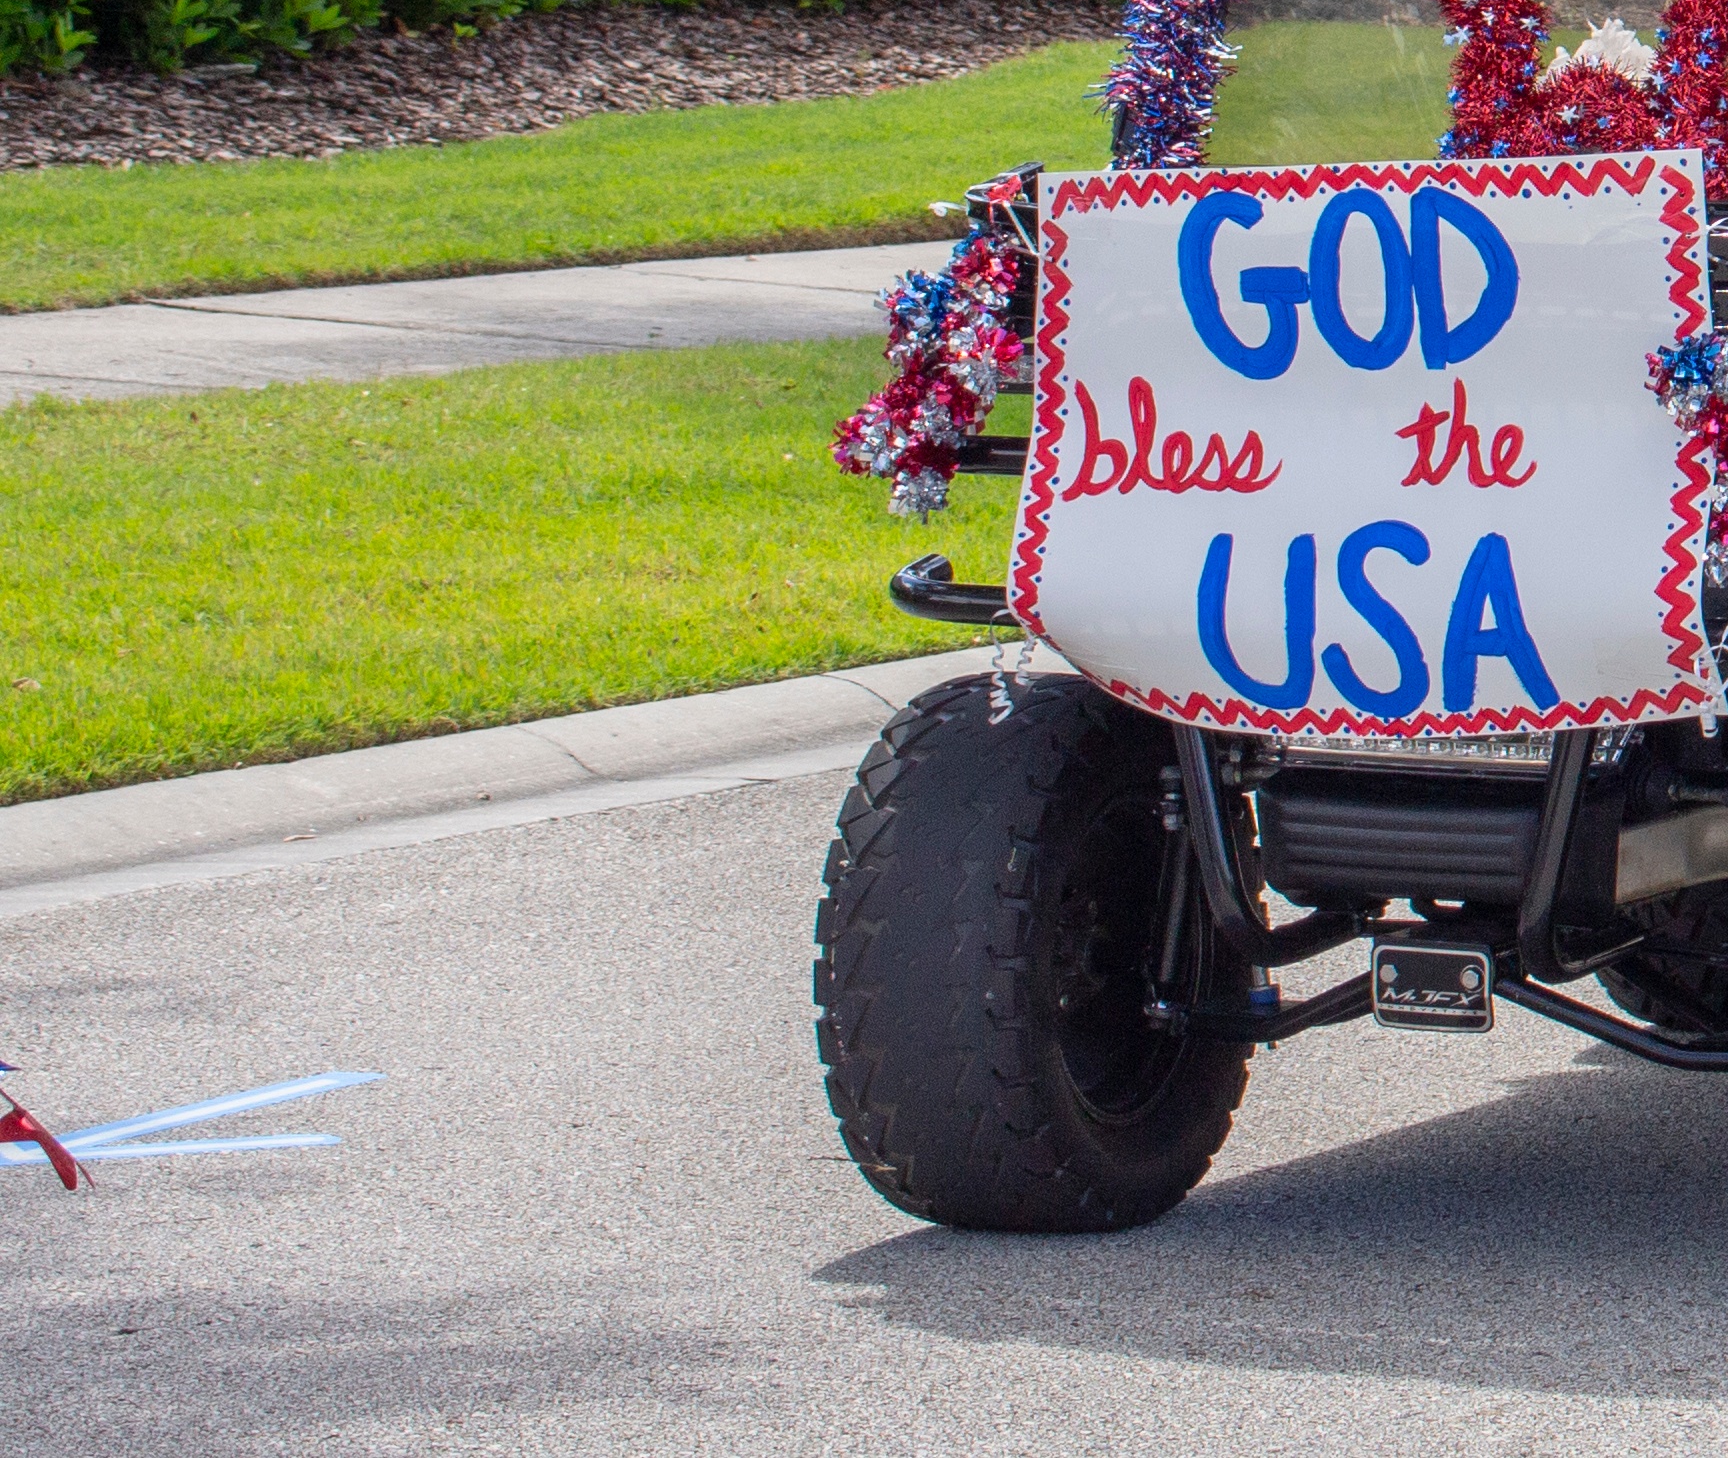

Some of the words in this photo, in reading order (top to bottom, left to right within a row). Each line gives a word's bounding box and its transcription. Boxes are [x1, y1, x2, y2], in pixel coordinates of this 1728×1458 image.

[1177, 185, 1520, 381] GOD
[1060, 375, 1284, 502] bless
[1393, 377, 1538, 492] the
[1195, 519, 1563, 717] USA
